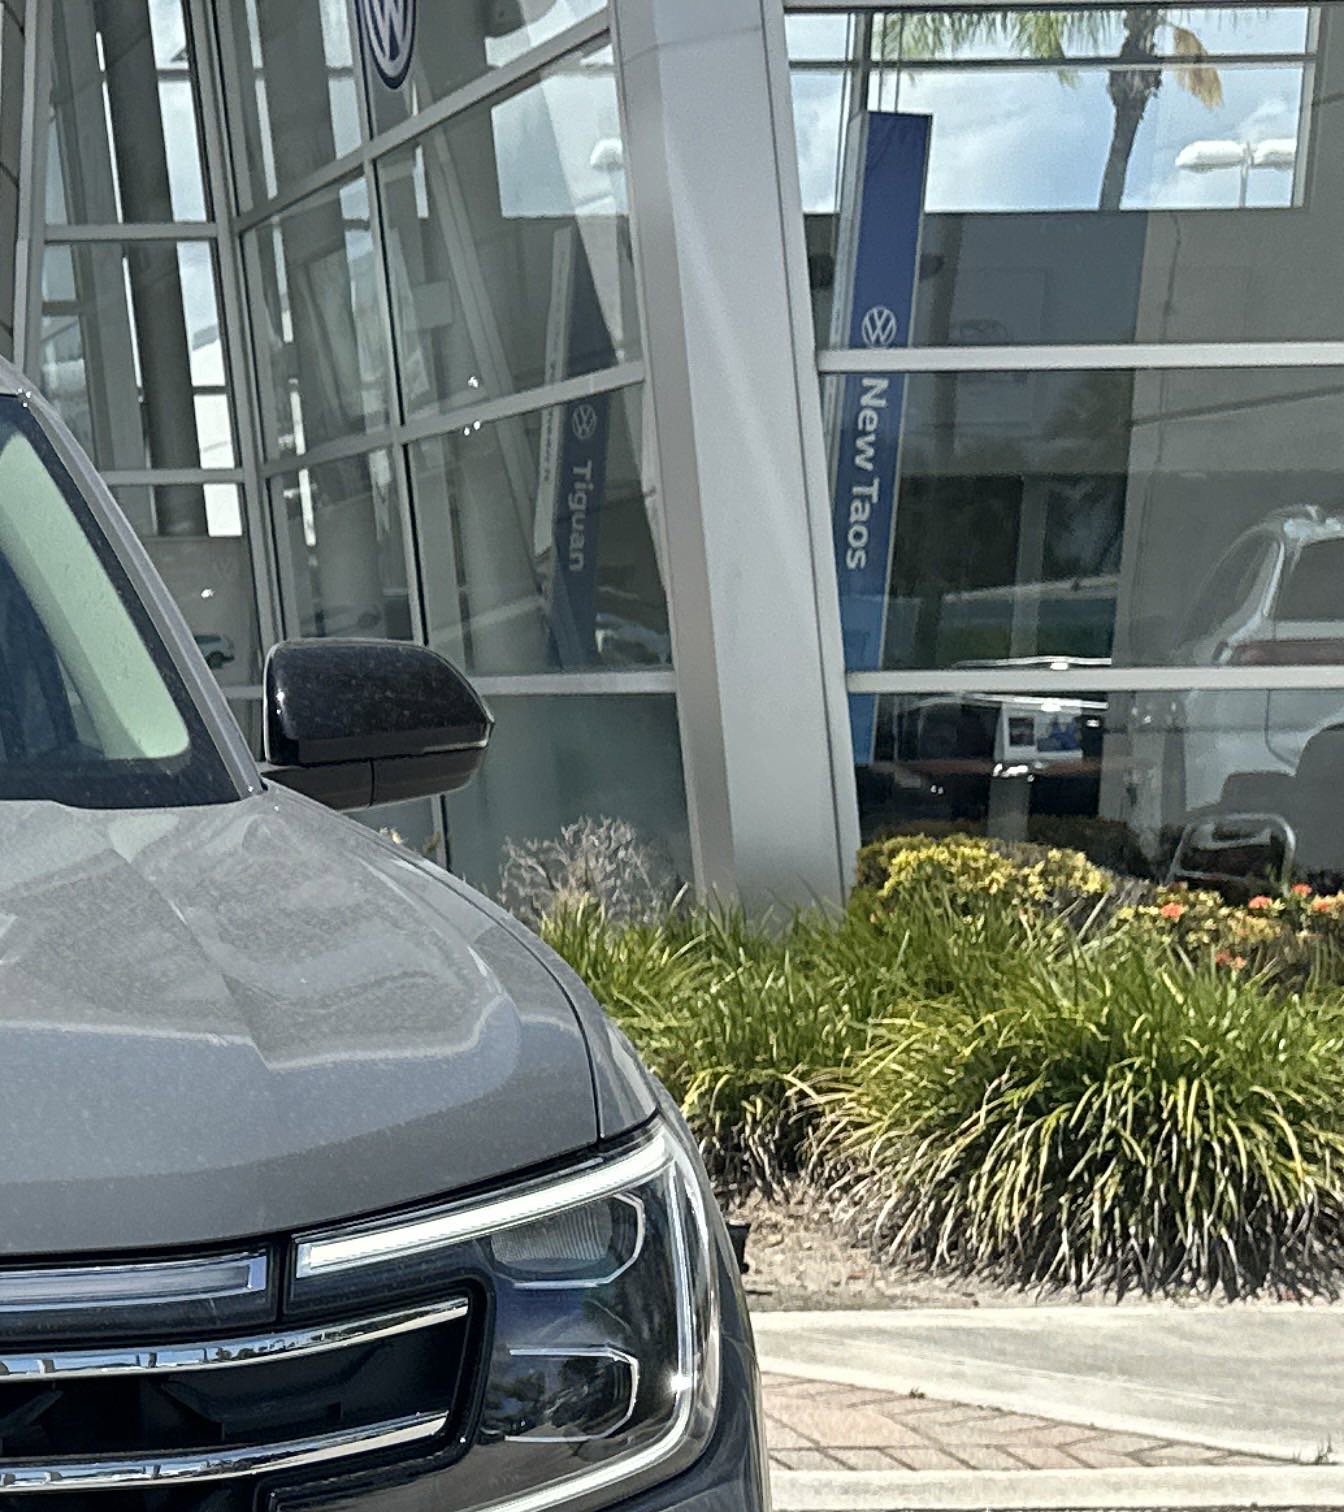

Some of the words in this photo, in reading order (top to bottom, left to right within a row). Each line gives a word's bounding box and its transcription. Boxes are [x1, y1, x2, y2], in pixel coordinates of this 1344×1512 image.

[855, 377, 889, 472] New
[567, 459, 594, 571] Tiguan
[846, 477, 881, 570] Taos
